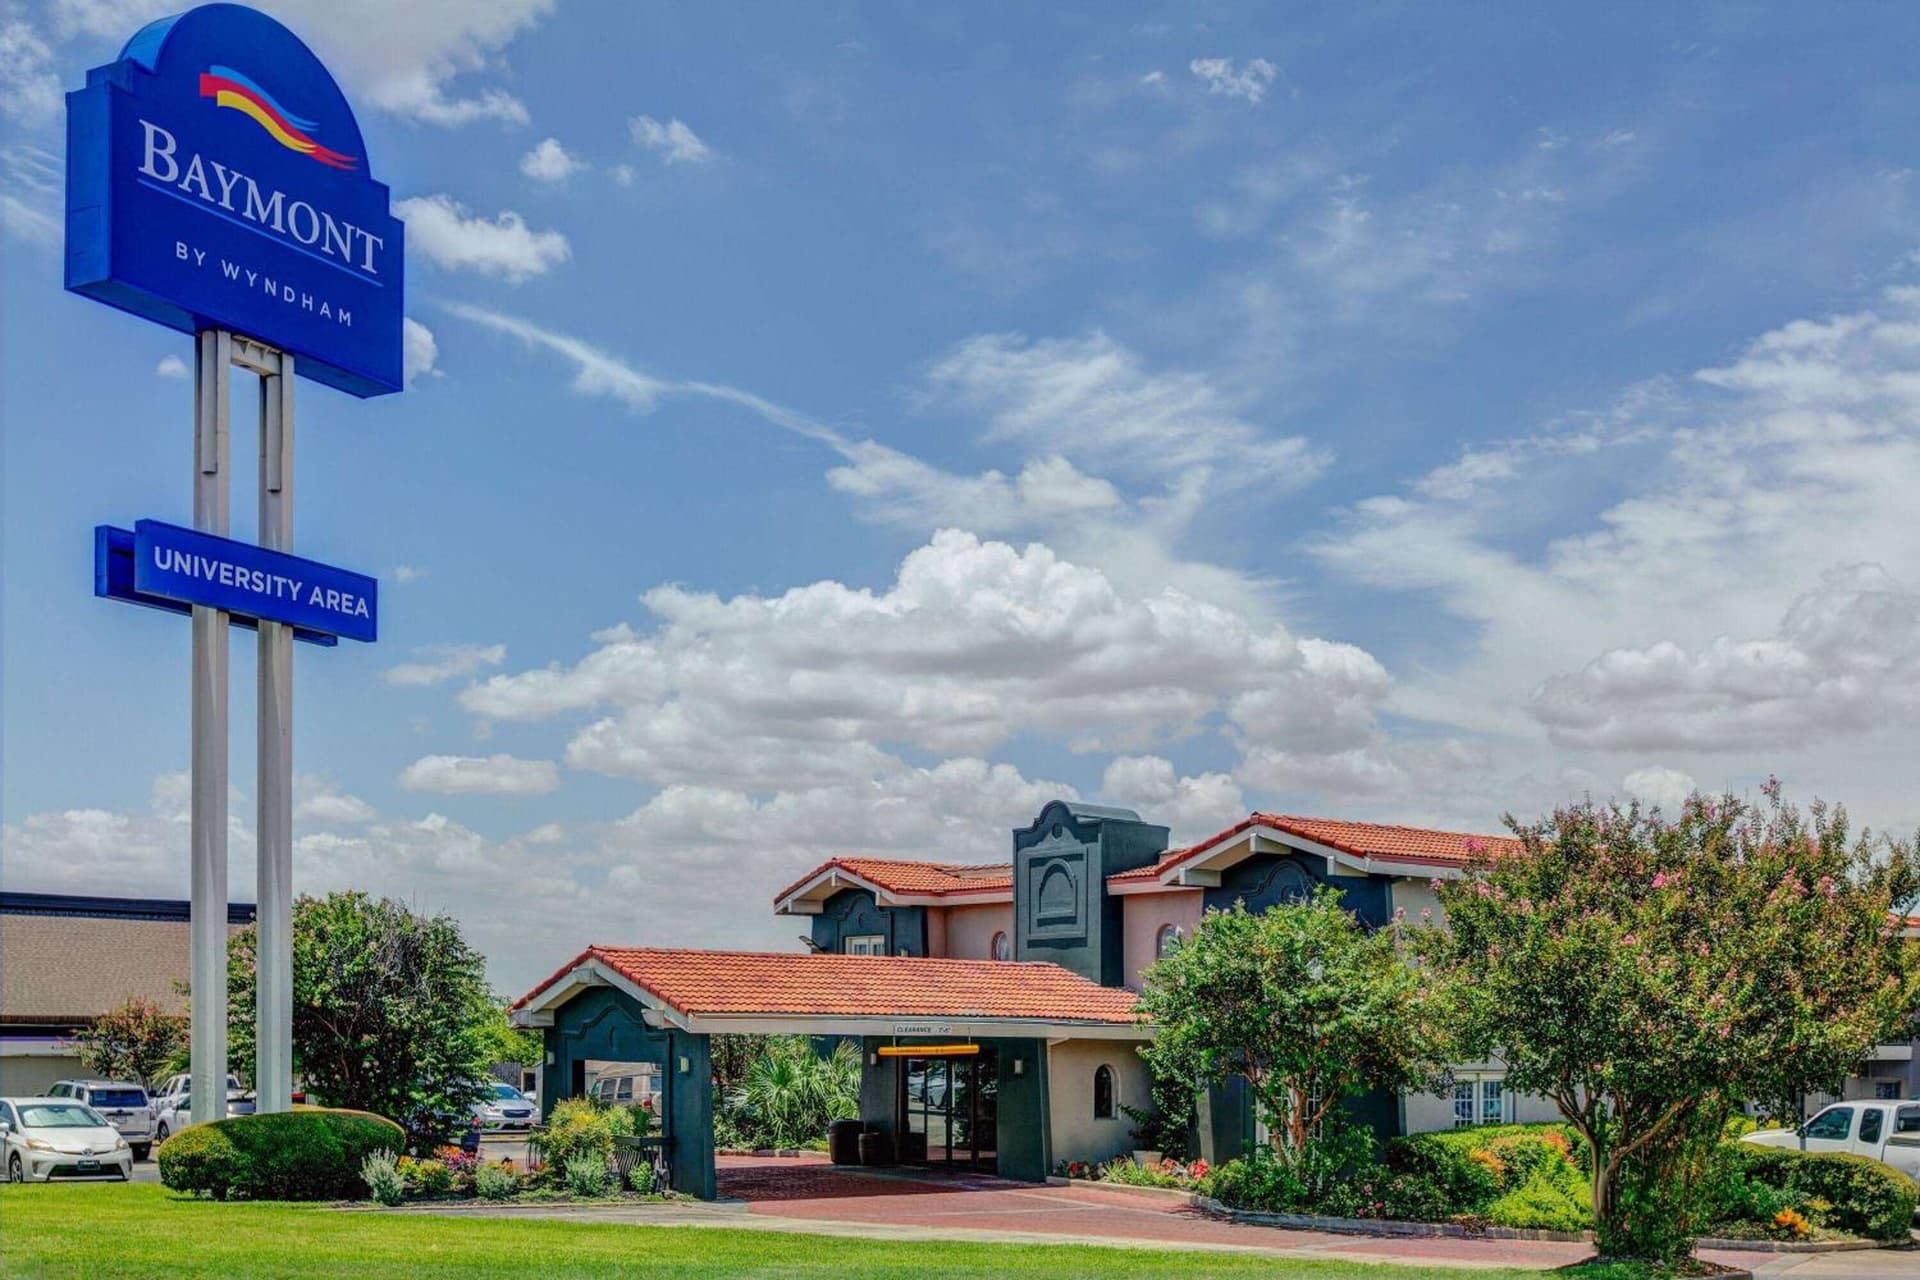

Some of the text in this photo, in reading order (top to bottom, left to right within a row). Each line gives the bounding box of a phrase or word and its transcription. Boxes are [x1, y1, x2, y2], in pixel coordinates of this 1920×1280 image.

[138, 119, 383, 274] BAYMONT
[176, 241, 351, 326] BY WYNDHAM
[154, 546, 369, 618] UNIVERSITY AREA
